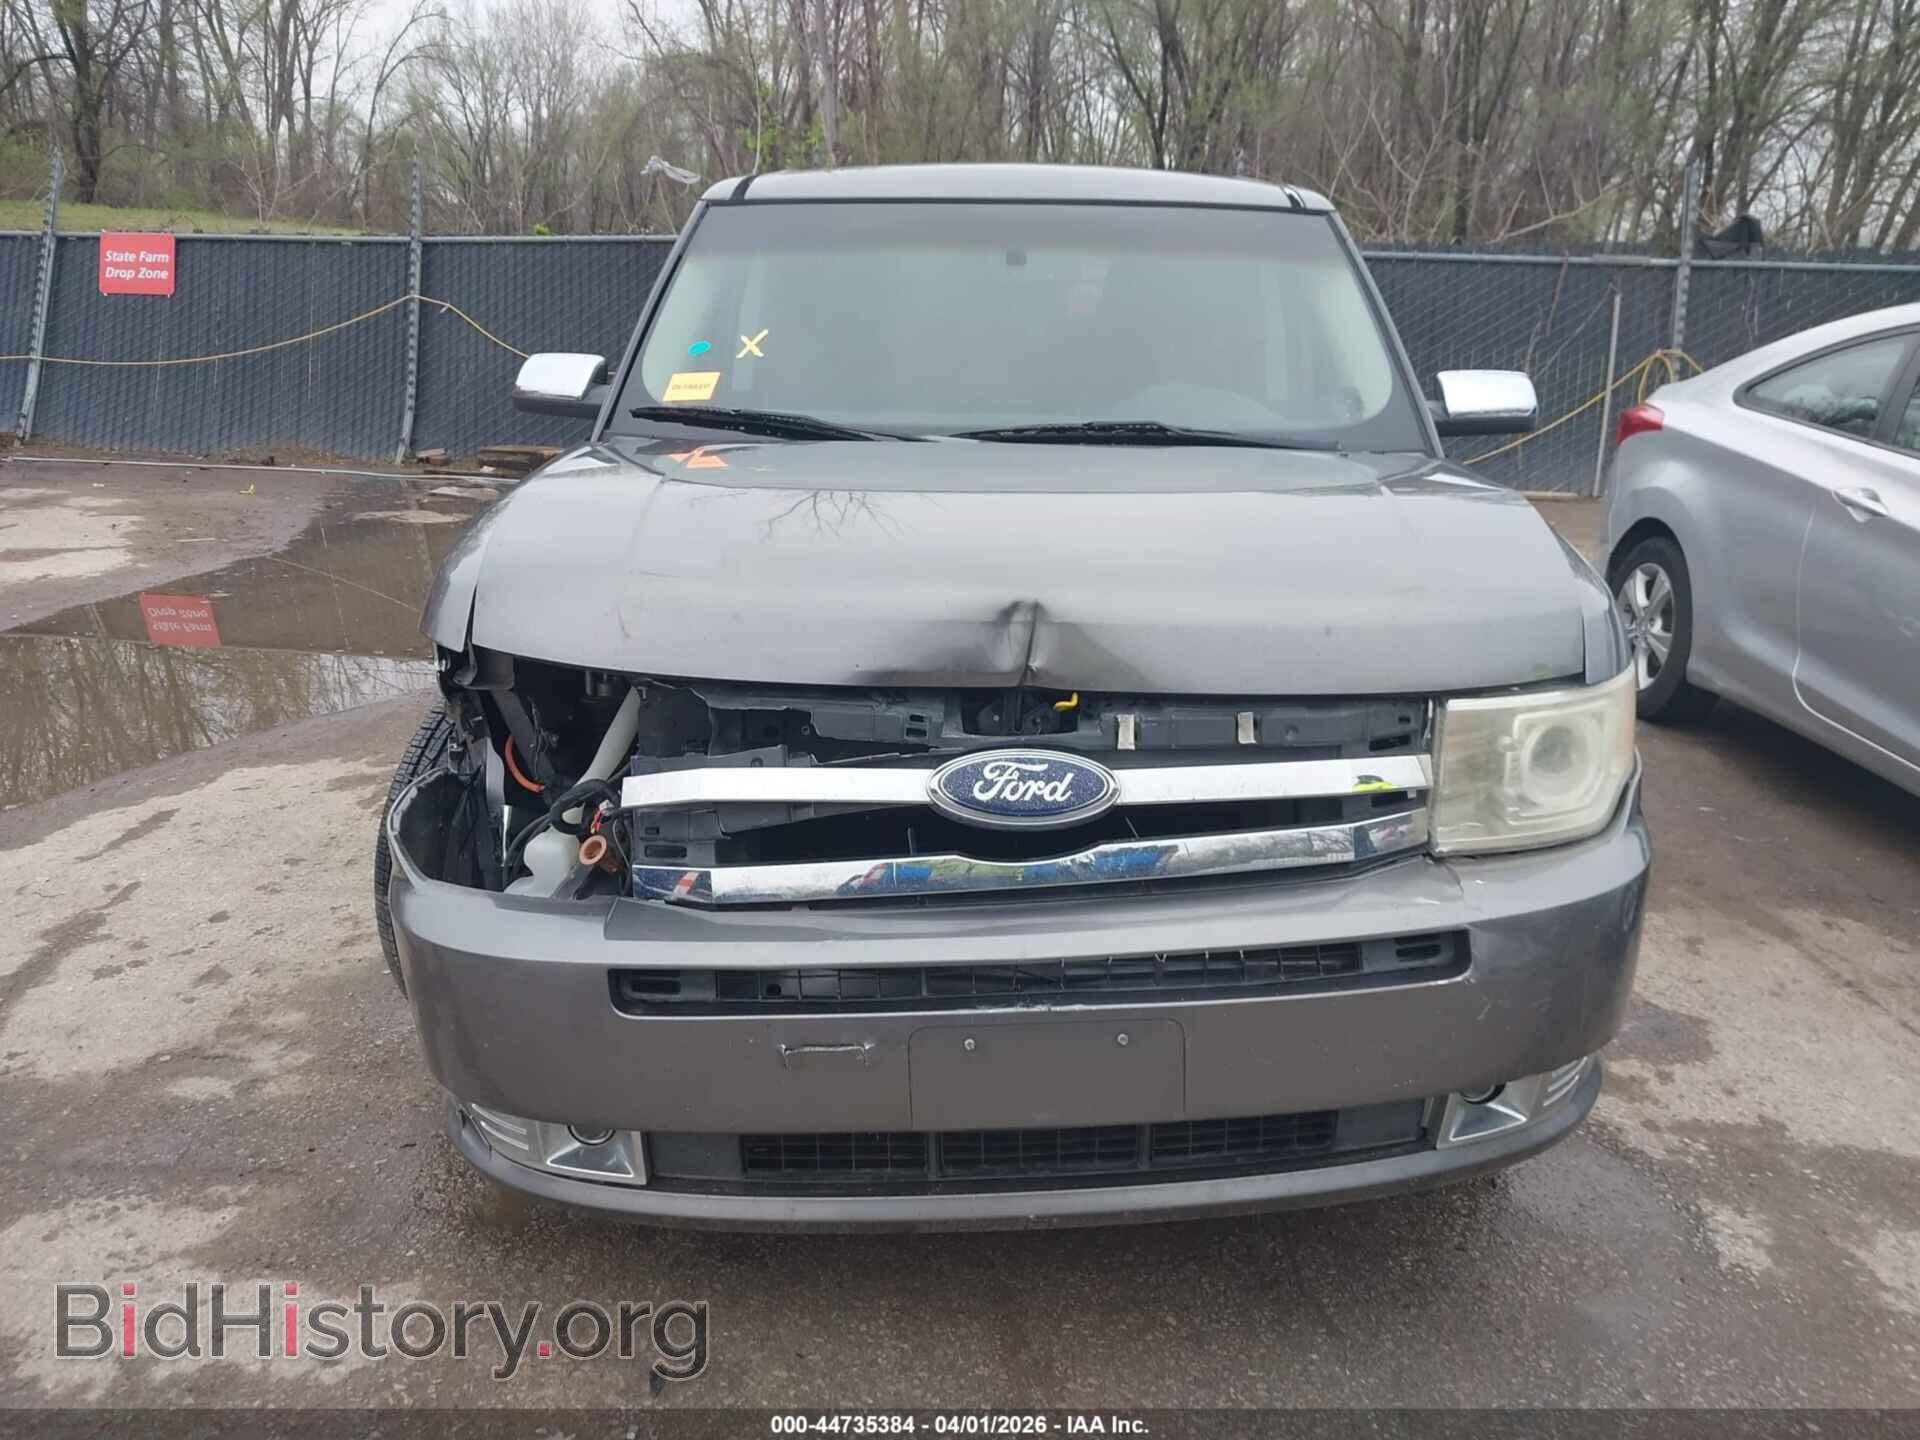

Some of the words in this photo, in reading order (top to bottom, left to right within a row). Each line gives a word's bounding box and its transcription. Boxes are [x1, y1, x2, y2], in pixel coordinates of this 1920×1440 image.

[104, 250, 136, 263] State
[138, 250, 169, 264] Farm
[104, 266, 135, 280] Drop
[137, 267, 169, 280] Zone
[972, 761, 1075, 802] Ford
